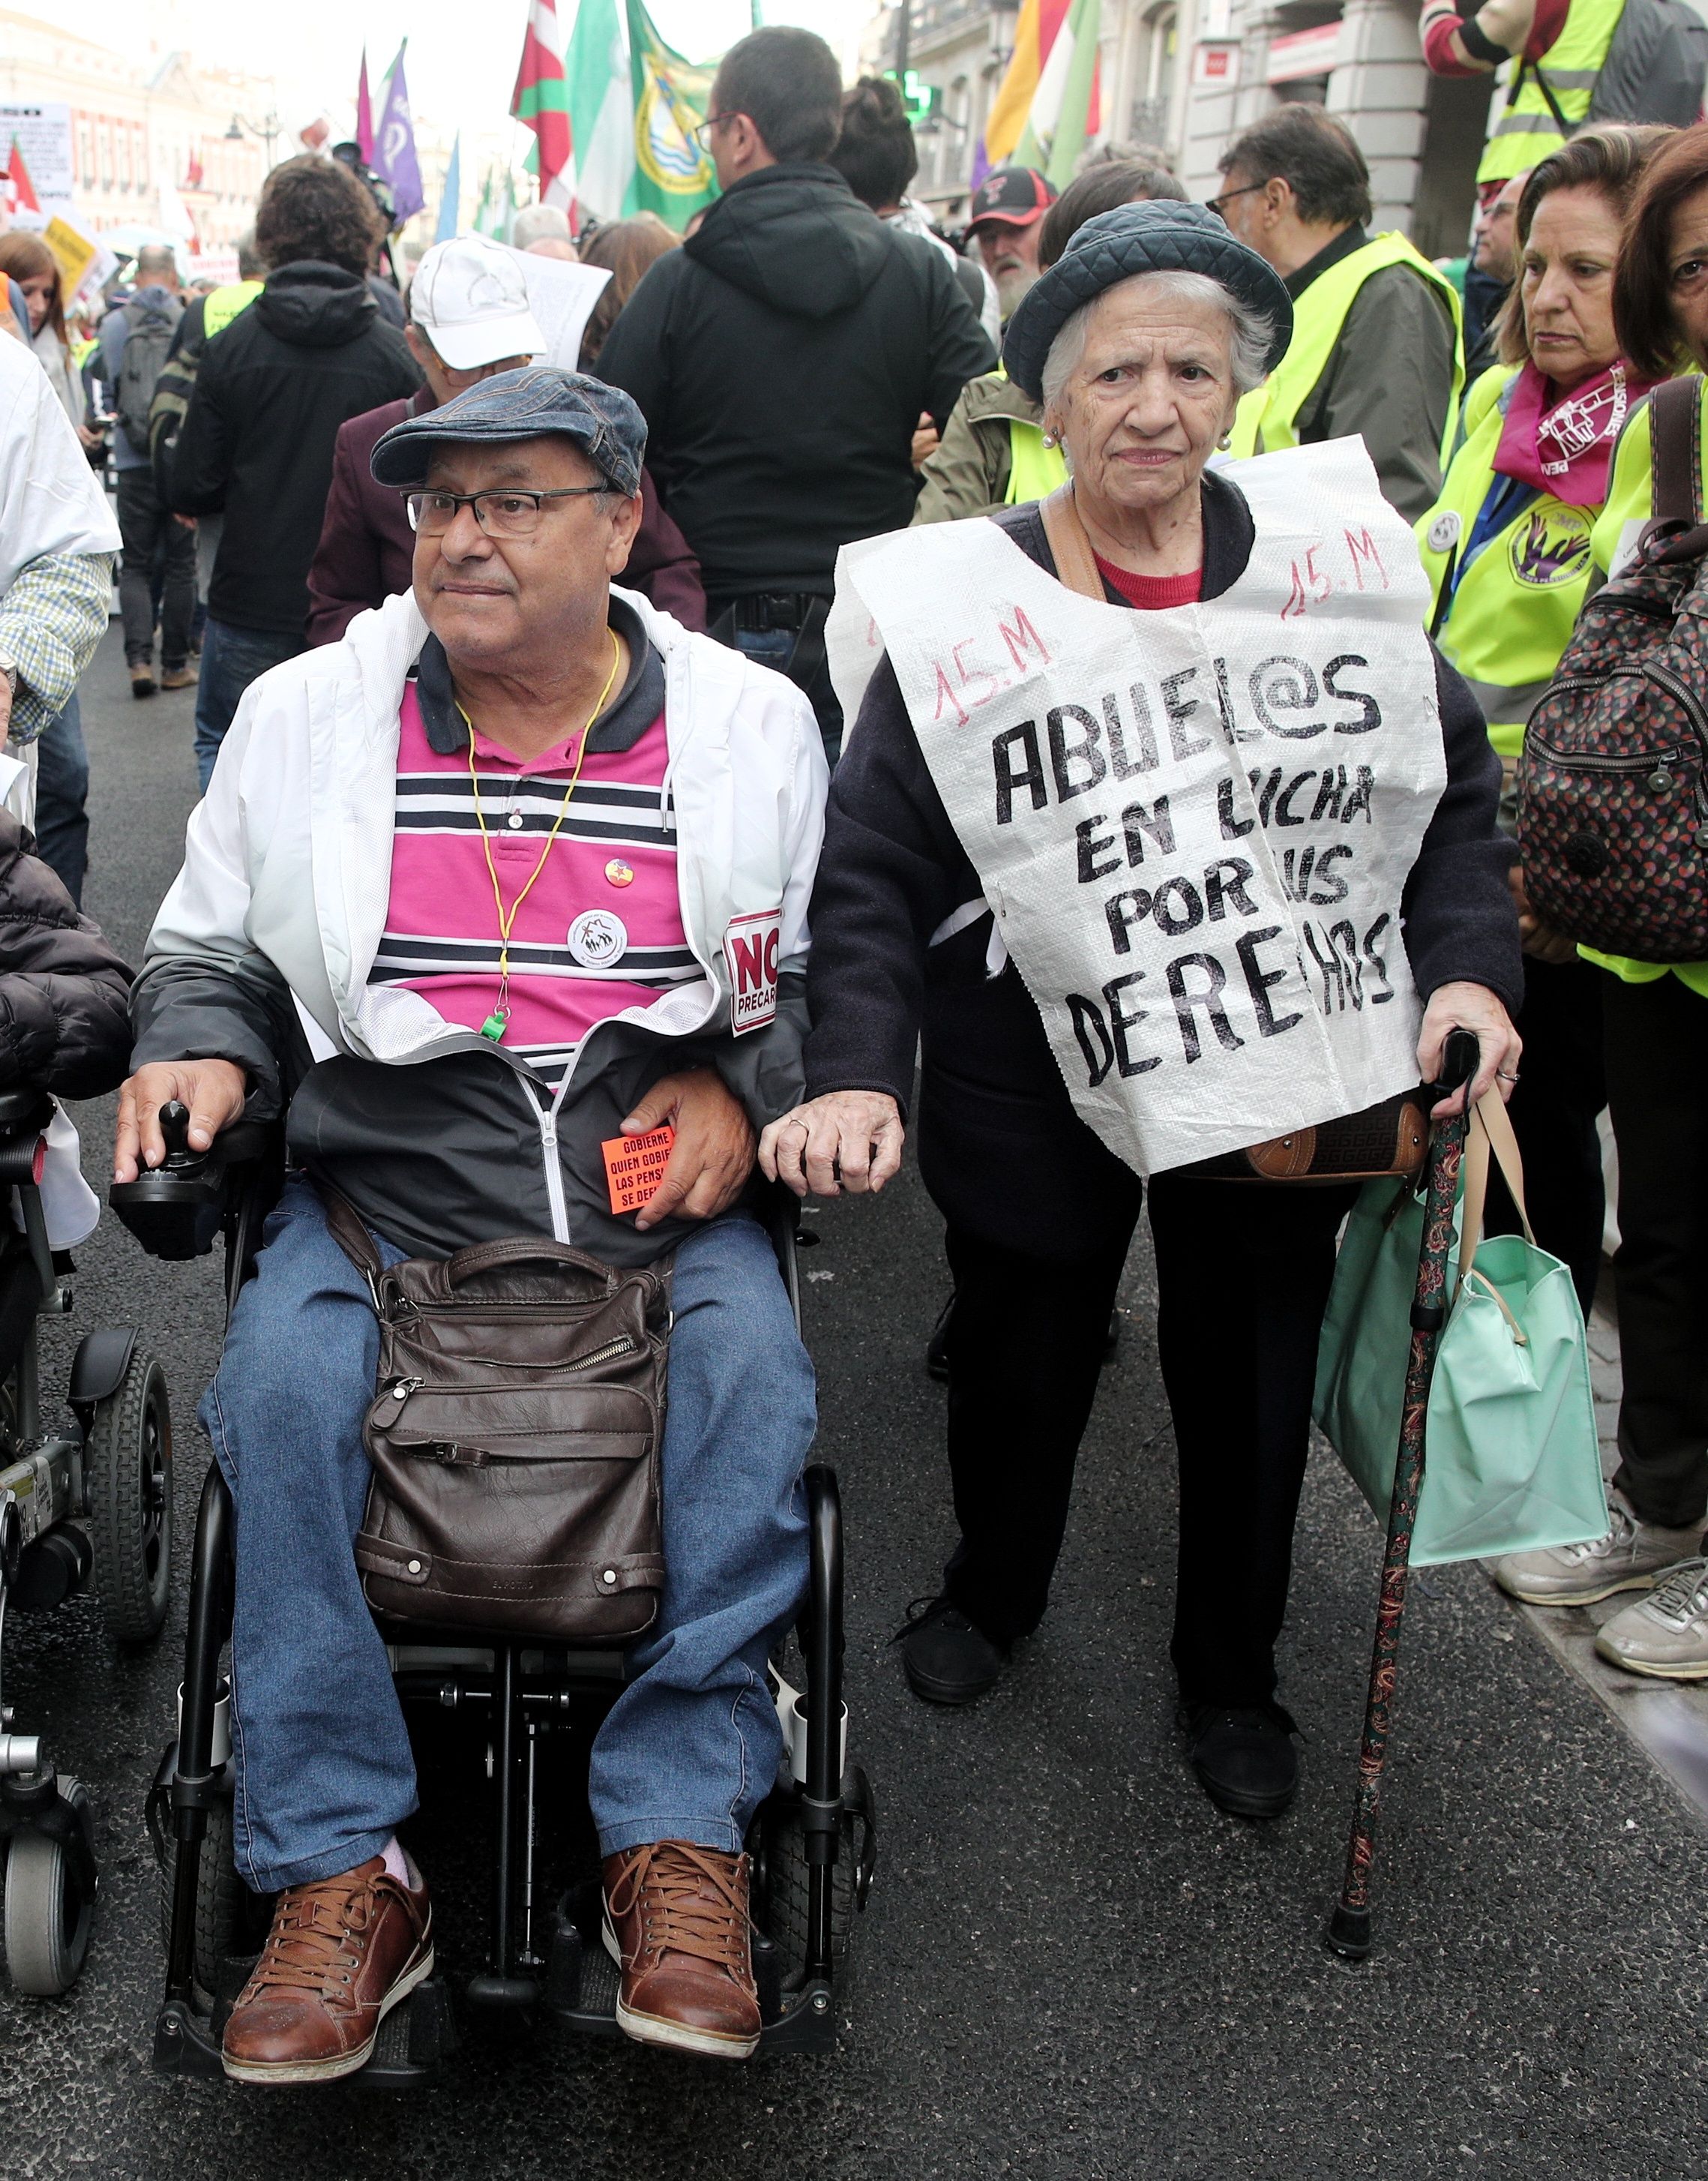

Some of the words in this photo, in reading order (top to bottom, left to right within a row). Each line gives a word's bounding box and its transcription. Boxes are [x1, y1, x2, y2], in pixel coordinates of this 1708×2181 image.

[991, 654, 1383, 825] ABUEL@S
[1077, 795, 1176, 884] EN
[1217, 764, 1374, 842] LUCHA
[1105, 856, 1259, 956] POR
[1065, 911, 1395, 1089] DEREHOS
[610, 1156, 640, 1174] QUIEN
[642, 1147, 673, 1166] GOBIE
[623, 1132, 670, 1154] GOBIERNE
[616, 1175, 634, 1191] LAS
[622, 1192, 634, 1207] SE
